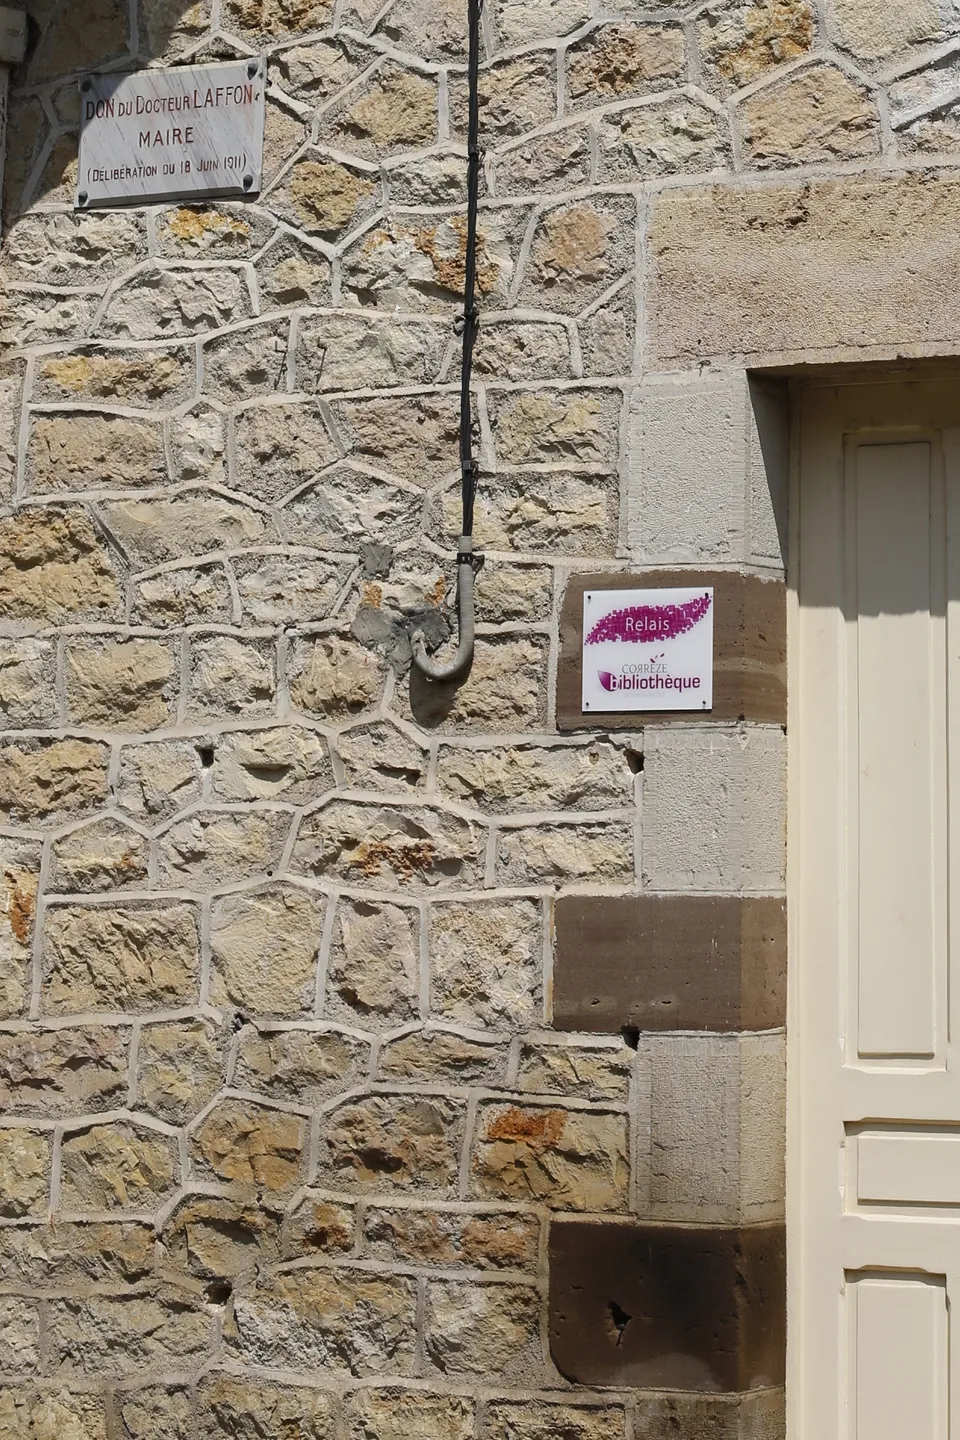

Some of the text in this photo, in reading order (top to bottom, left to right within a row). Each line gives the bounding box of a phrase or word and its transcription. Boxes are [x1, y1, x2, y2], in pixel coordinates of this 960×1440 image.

[85, 98, 115, 121] DON
[118, 101, 133, 116] DU
[136, 95, 190, 115] DOCTEUR
[139, 126, 194, 148] MAIRE
[87, 153, 248, 185] (DÉLIBÉRATION DU 18 JUIN 1911)
[625, 617, 670, 632] Relais
[609, 674, 701, 693] bibliothèque
